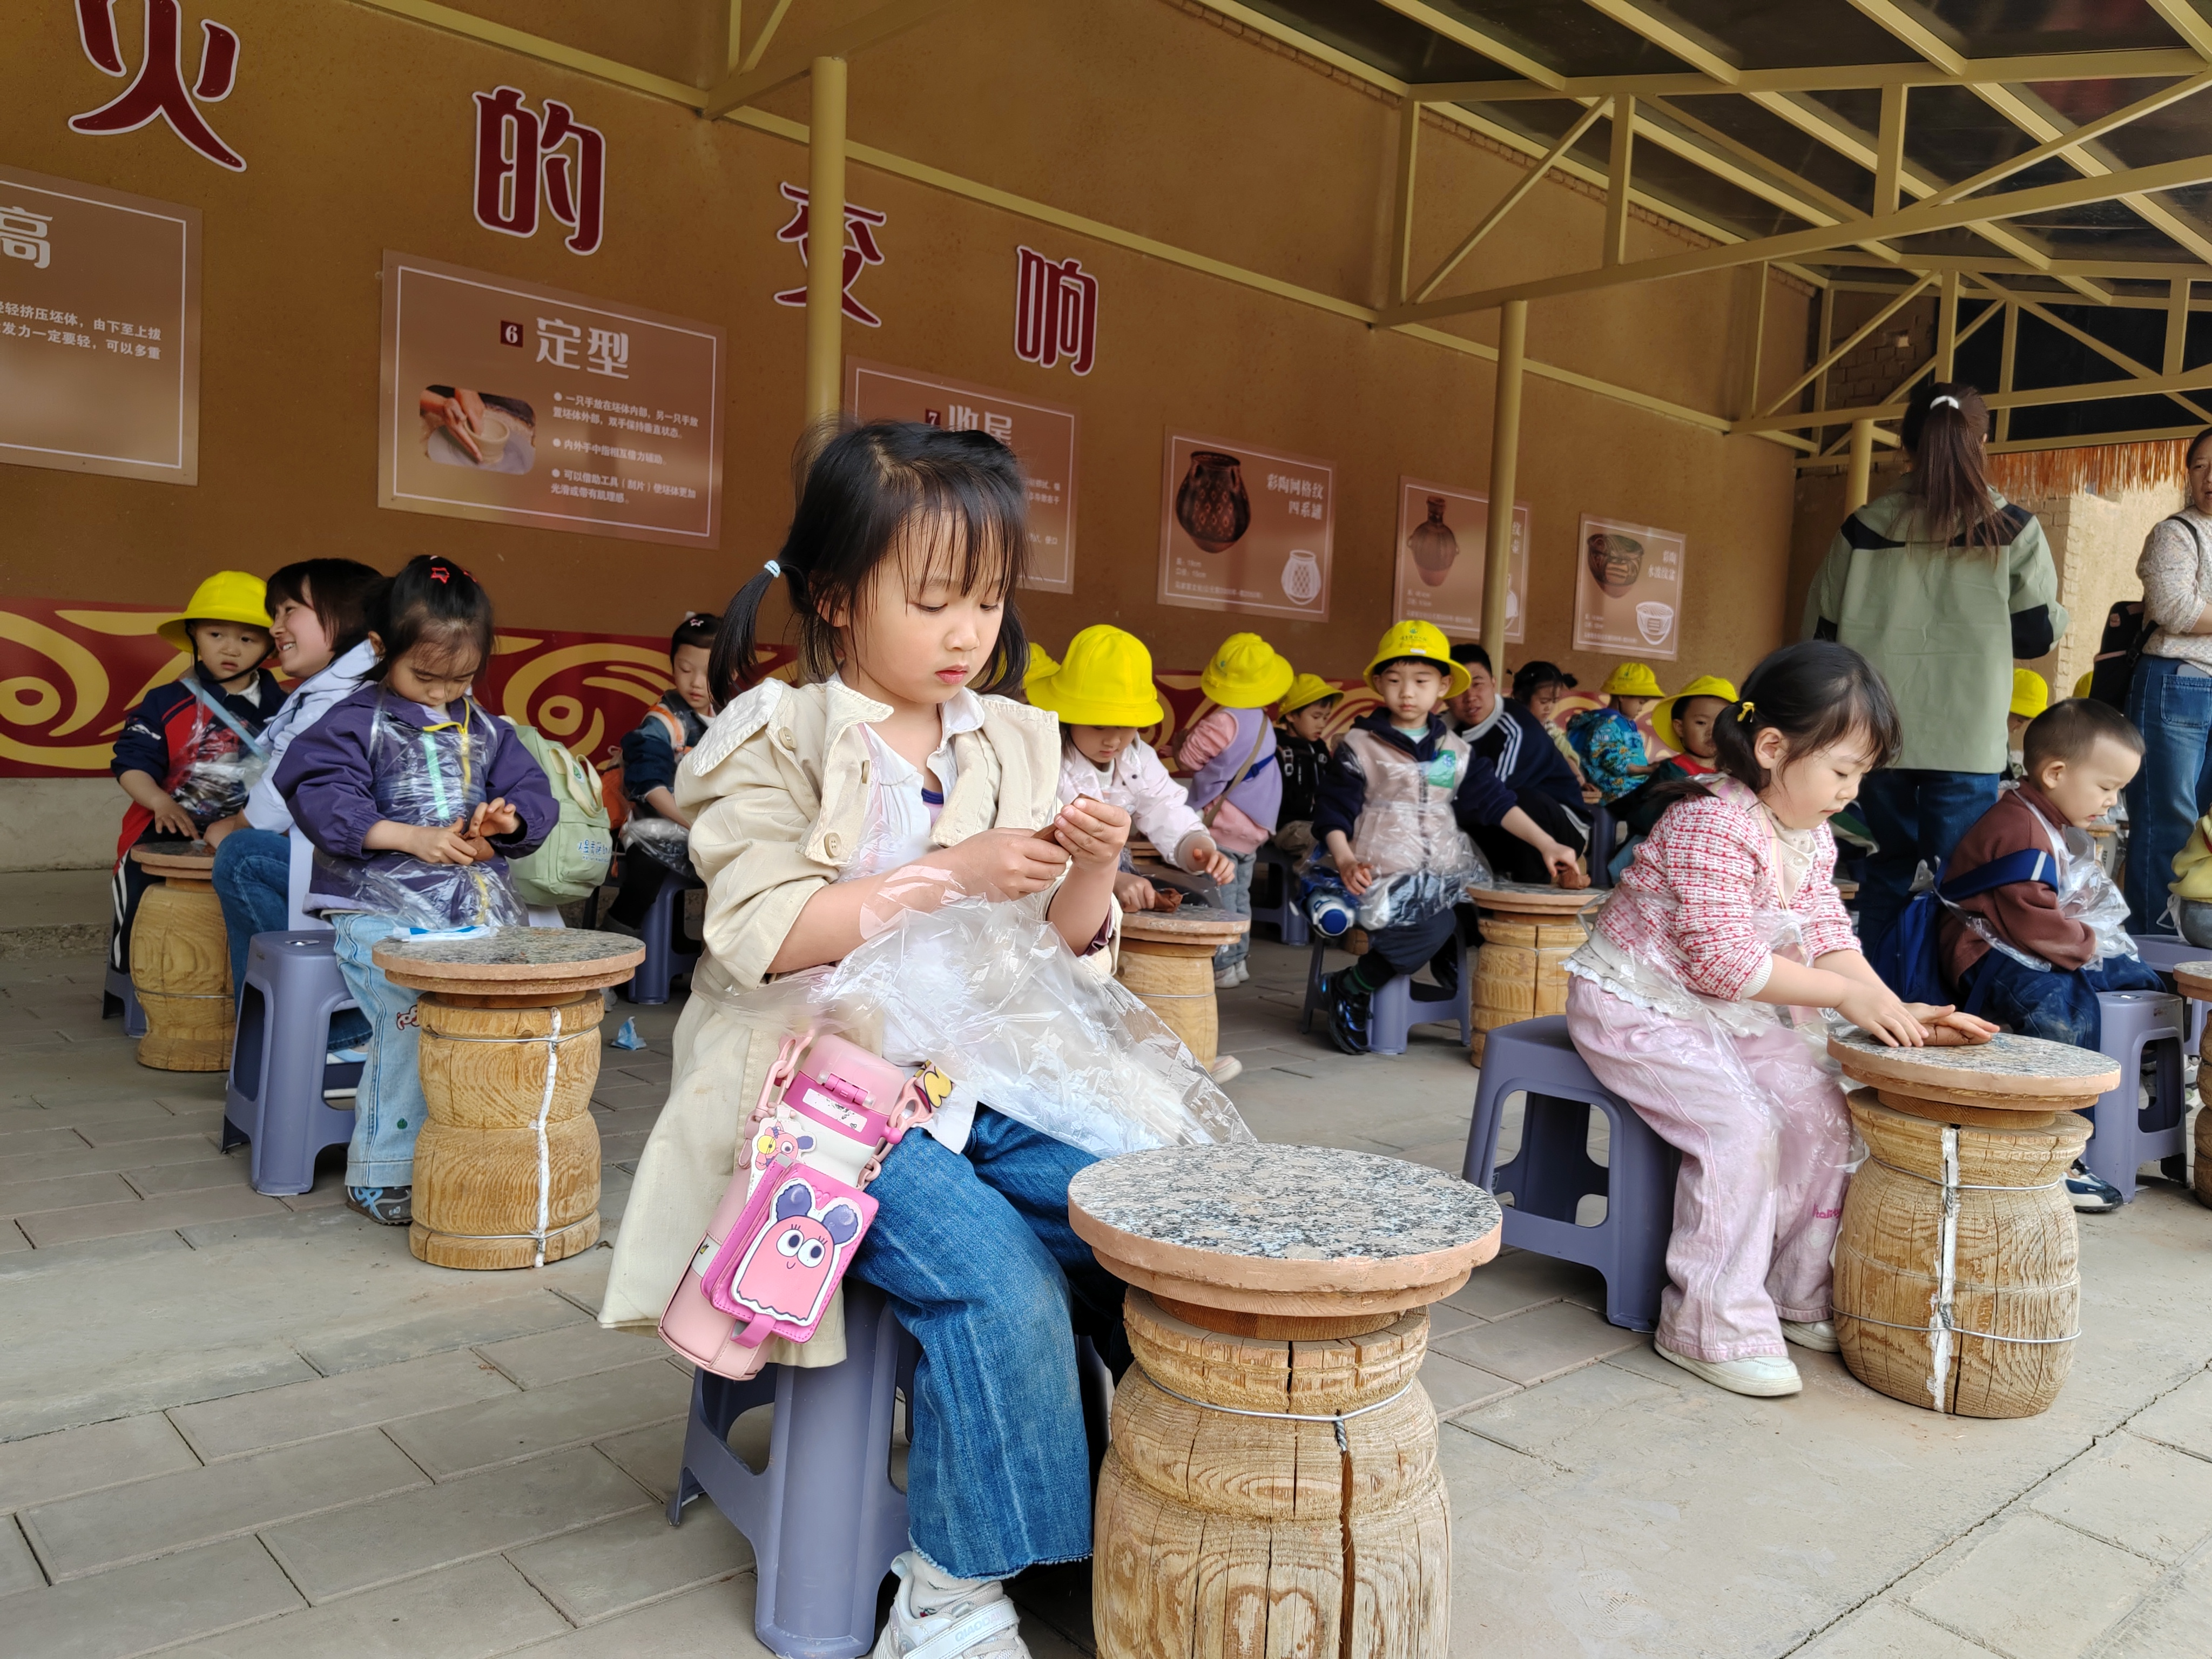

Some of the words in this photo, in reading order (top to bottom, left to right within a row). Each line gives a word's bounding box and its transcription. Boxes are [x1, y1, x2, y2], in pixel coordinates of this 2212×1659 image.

[0, 206, 53, 269] 高
[0, 301, 161, 341] 轻挤压坯体，由下至上拔
[0, 322, 161, 360] 发力一定要轻，可以多重
[505, 325, 518, 344] 6
[536, 317, 629, 379] 定型
[928, 412, 938, 427] 7
[955, 1609, 1004, 1642] QIAODAN
